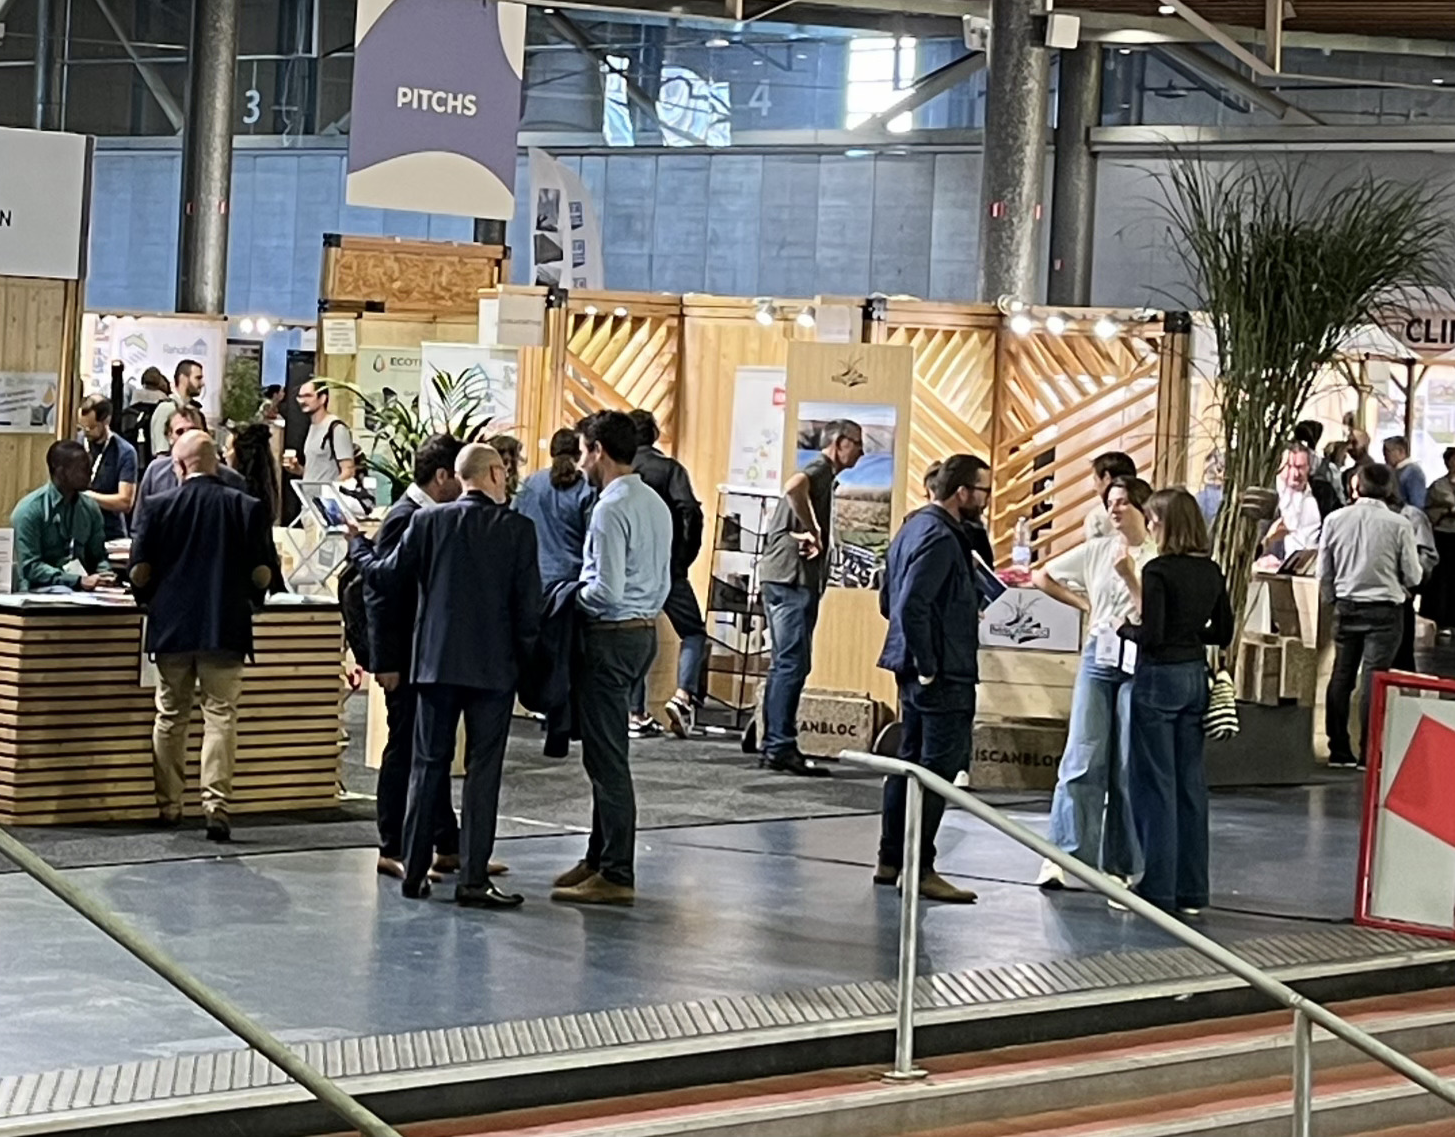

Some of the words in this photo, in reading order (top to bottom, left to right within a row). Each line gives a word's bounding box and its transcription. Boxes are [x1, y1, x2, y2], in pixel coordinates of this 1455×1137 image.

[242, 89, 260, 124] 3
[397, 86, 477, 117] PITCHS
[748, 79, 772, 117] 4
[799, 720, 857, 737] ANBLOC
